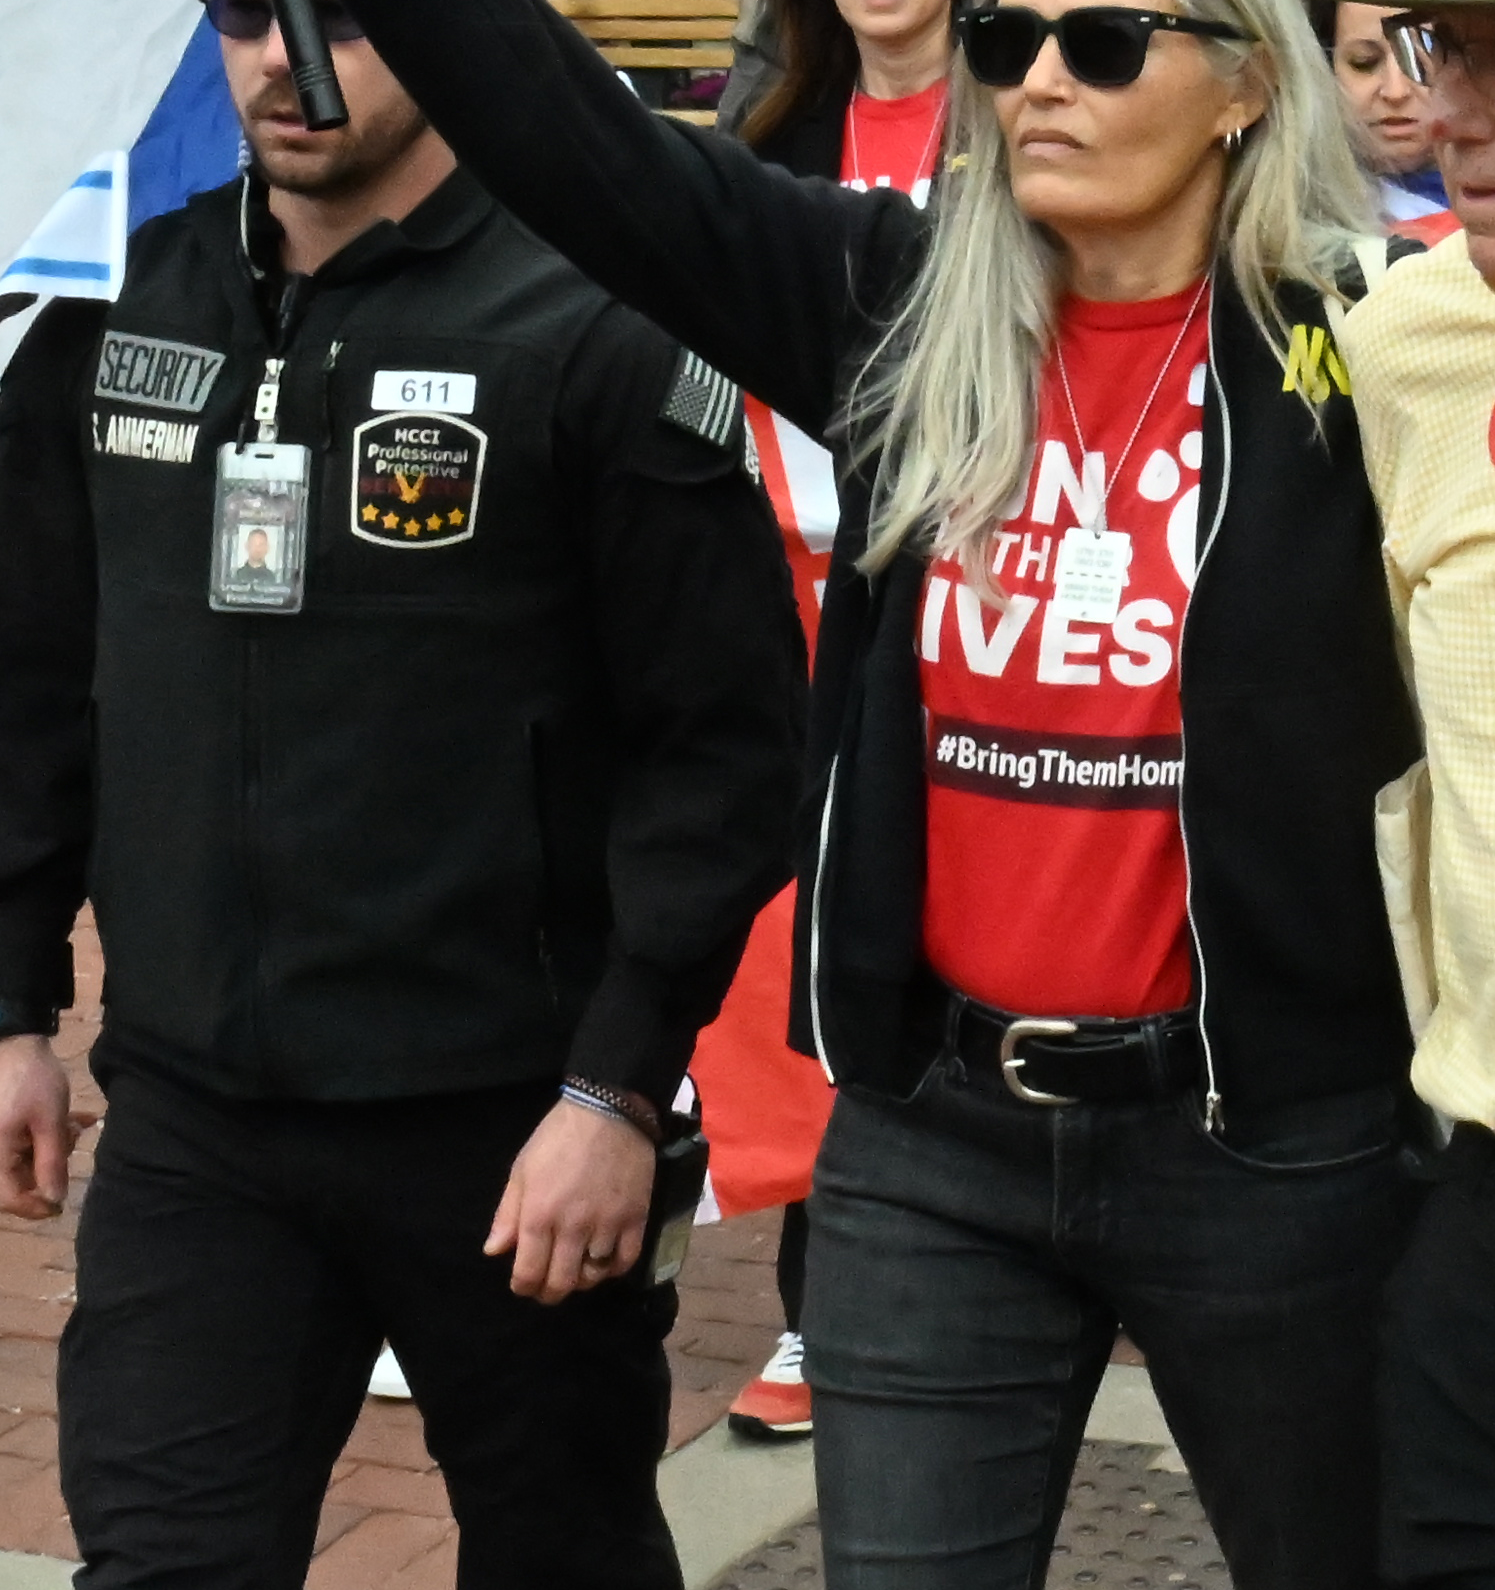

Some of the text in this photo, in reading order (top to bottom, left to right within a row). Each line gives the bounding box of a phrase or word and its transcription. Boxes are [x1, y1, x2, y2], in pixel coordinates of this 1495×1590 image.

[99, 339, 219, 405] SECURITY
[401, 379, 450, 404] 611
[105, 414, 200, 463] AMMERMAN
[367, 444, 469, 464] Professional
[375, 459, 461, 479] Protective
[920, 576, 1174, 688] IVES
[936, 734, 1184, 789] #BringThemHom
